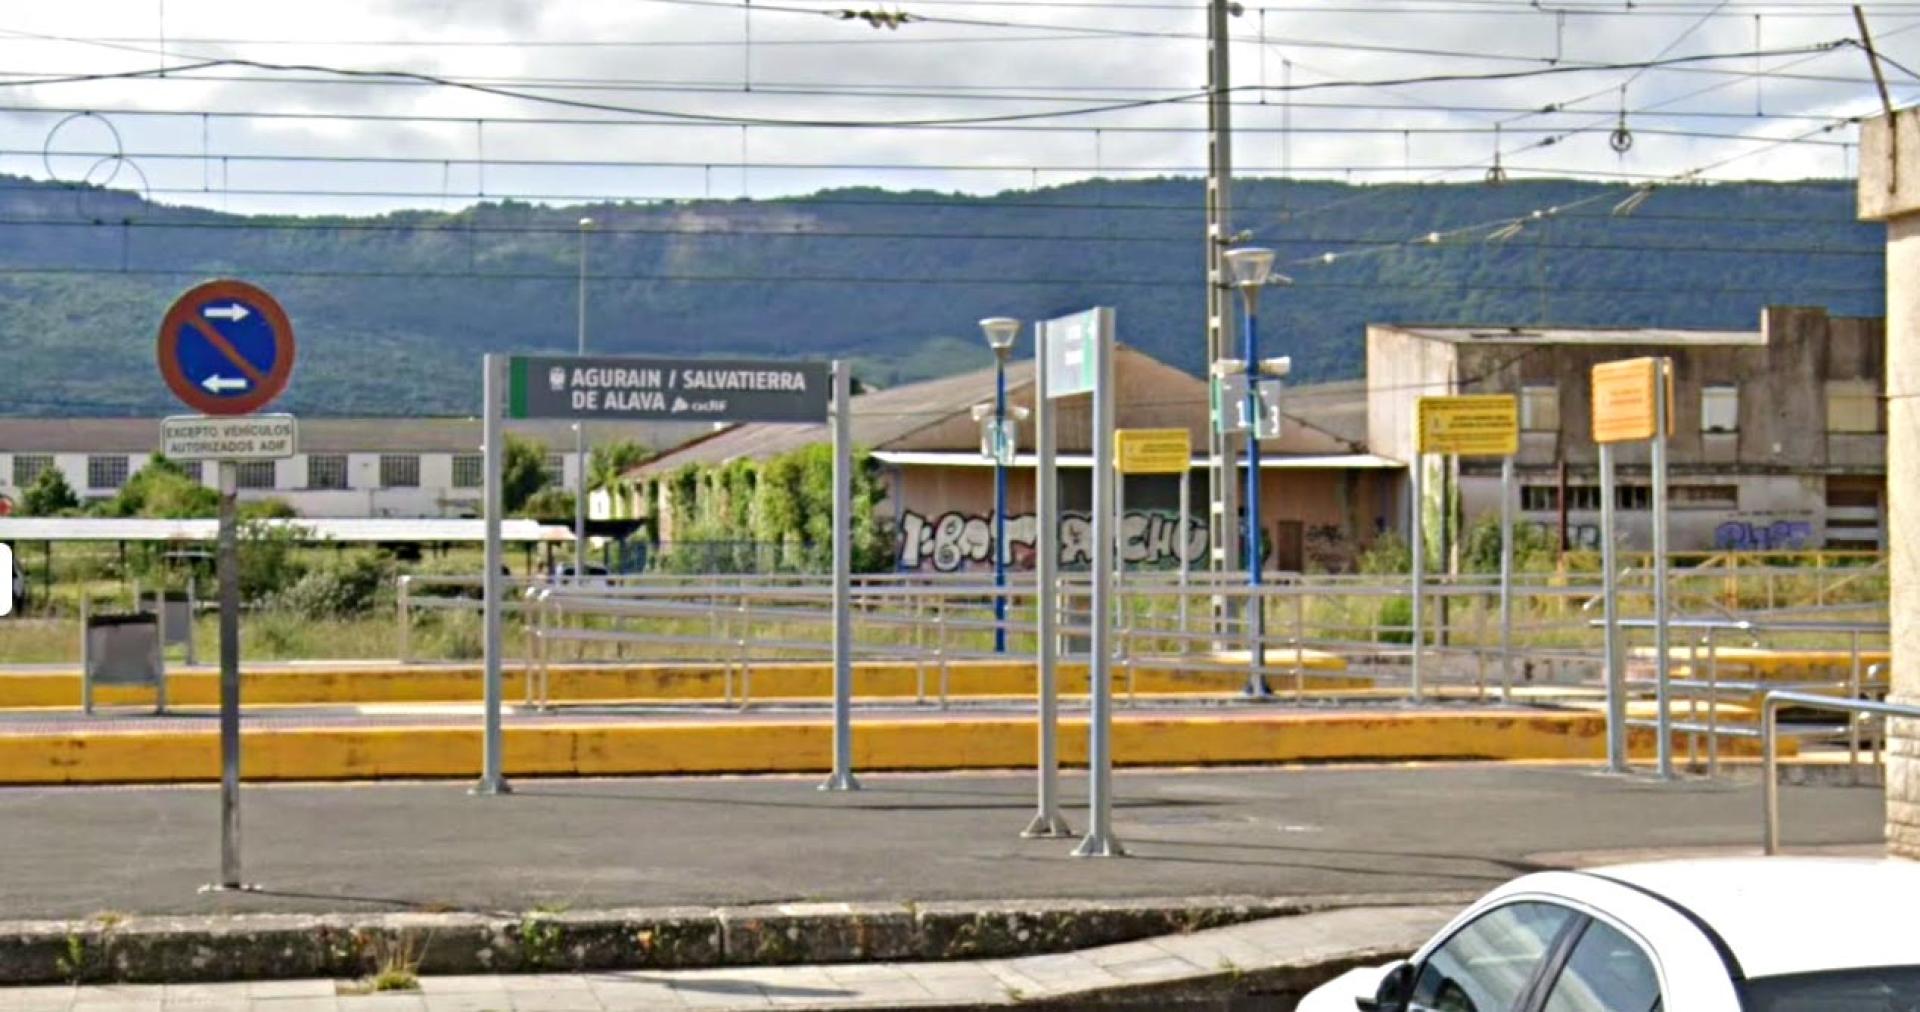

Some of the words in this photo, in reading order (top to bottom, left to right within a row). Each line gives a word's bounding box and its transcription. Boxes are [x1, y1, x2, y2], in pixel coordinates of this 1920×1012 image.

[571, 367, 661, 388] AGURAIN
[683, 369, 806, 390] SALVATIERRA
[572, 391, 597, 409] DE
[604, 391, 666, 410] ALAVA
[166, 426, 217, 438] EXCEPTO
[171, 440, 254, 452] AUTORIZADOS
[260, 440, 286, 450] ADIF
